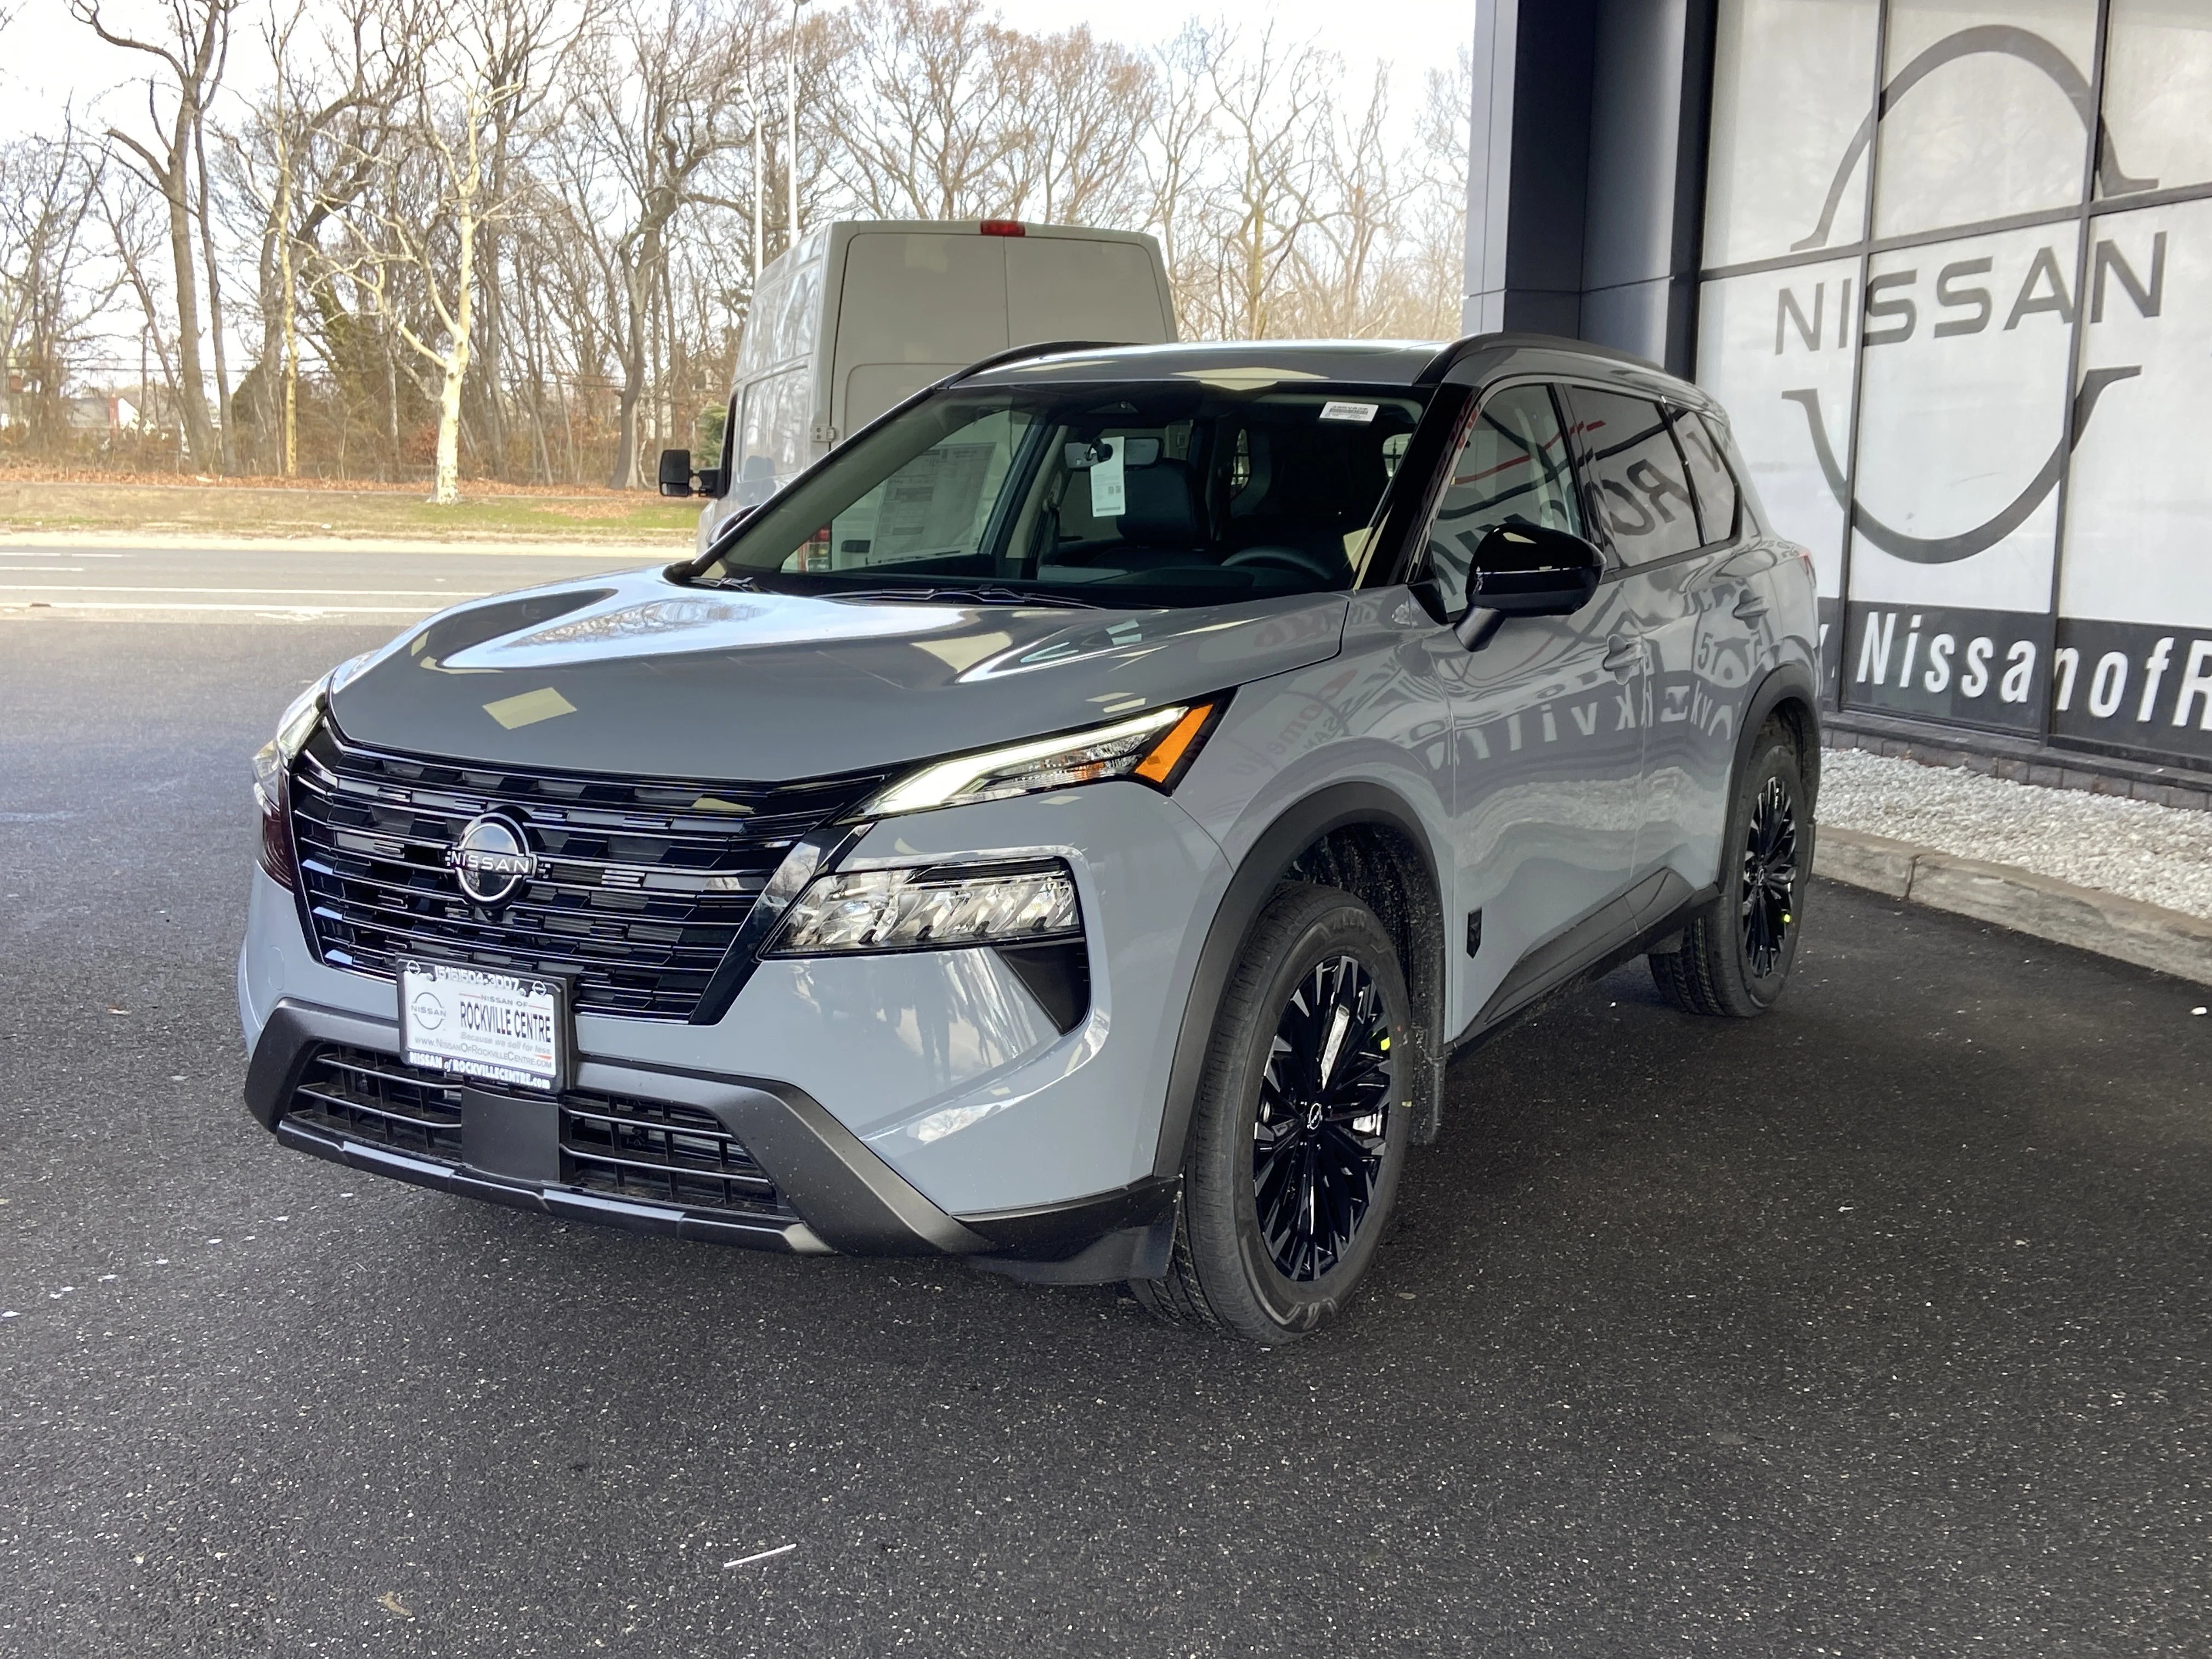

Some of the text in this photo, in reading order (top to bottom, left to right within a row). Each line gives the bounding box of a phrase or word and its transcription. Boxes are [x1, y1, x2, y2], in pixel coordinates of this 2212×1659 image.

[1775, 231, 2167, 355] NISSAN
[451, 851, 529, 873] NISSAN
[481, 995, 513, 1005] NISSAN
[411, 1005, 447, 1017] NISSAN
[460, 1001, 551, 1043] ROCKVILLE CENTRE
[461, 1031, 493, 1044] Because
[522, 1043, 533, 1051] for
[409, 1052, 443, 1069] NISSAN
[444, 1059, 453, 1072] of
